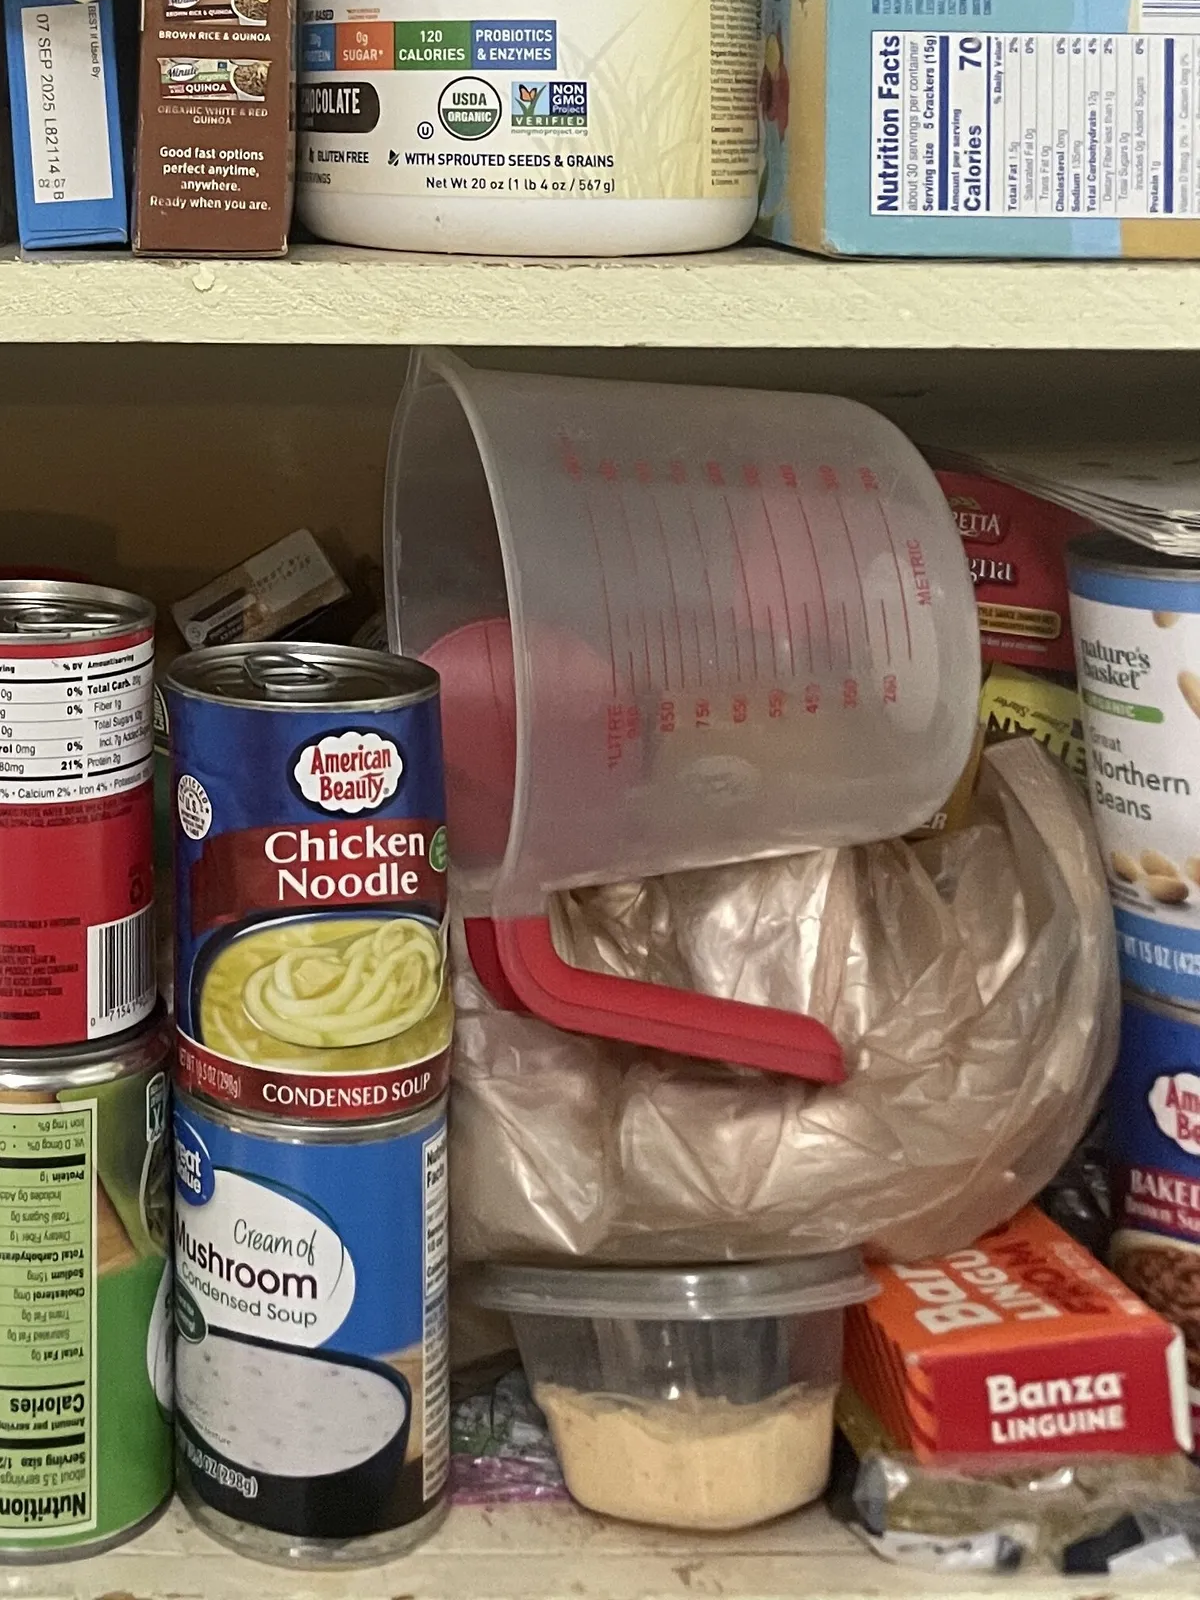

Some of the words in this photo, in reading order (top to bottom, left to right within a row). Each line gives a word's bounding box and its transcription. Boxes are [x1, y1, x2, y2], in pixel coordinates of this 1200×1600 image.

[36, 13, 50, 32] 07
[356, 31, 368, 45] 0g
[420, 30, 443, 43] 120
[475, 29, 553, 42] PROBIOTICS
[38, 38, 52, 69] SEP
[399, 49, 465, 61] CALORIES
[477, 49, 486, 60] &
[490, 48, 552, 61] ENZYMES
[960, 38, 982, 70] 70
[877, 36, 900, 104] Facts
[40, 75, 55, 111] 2025
[452, 92, 487, 106] USDA
[553, 85, 584, 94] NON
[553, 95, 585, 105] GMO
[448, 111, 491, 122] ORGANIC
[515, 116, 585, 125] VERIFIED
[877, 110, 900, 212] Nutrition
[964, 125, 982, 212] Calories
[906, 538, 934, 608] METRIC
[1080, 637, 1150, 669] nature's
[310, 744, 391, 776] American
[1092, 749, 1190, 796] Northern
[320, 771, 383, 803] Beauty
[1096, 784, 1151, 821] Beans
[264, 826, 424, 864] Chicken
[278, 868, 418, 900] Noodle
[262, 1078, 388, 1108] CONDENSED
[391, 1072, 430, 1101] SOUP
[233, 1218, 293, 1257] Cream
[296, 1229, 316, 1266] of
[182, 1261, 261, 1317] Condensed
[267, 1301, 318, 1327] Soup
[10, 1393, 85, 1412] Calories
[985, 1372, 1122, 1413] Banza
[991, 1405, 1126, 1444] LINGUINE
